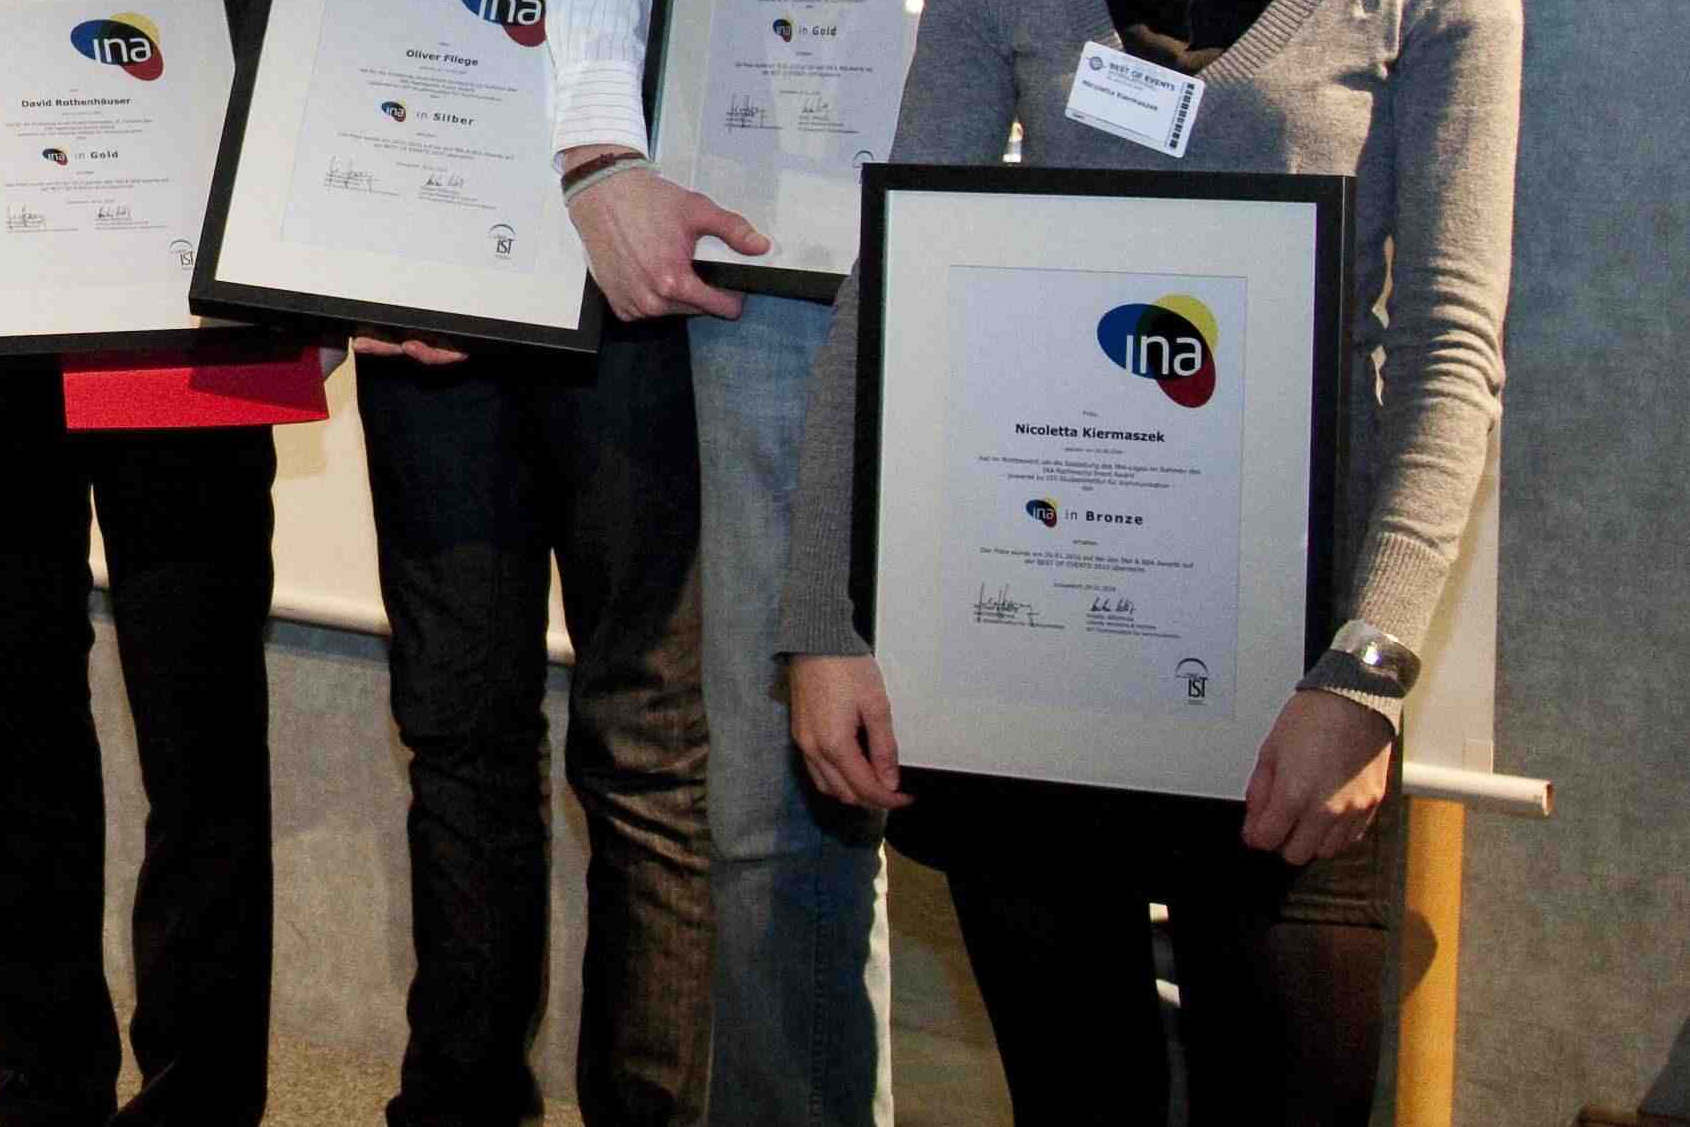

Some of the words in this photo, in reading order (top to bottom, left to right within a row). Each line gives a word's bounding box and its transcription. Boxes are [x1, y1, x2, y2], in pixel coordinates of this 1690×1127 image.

[812, 26, 837, 36] Gold
[406, 49, 441, 61] Oliver
[443, 54, 479, 67] Fliege
[21, 99, 52, 108] David
[432, 112, 475, 126] Silber
[90, 150, 119, 159] Gold
[1015, 423, 1078, 439] Nicoletta
[1082, 426, 1166, 443] Kiermaszek
[1064, 509, 1078, 520] in
[1085, 510, 1143, 525] Bronze
